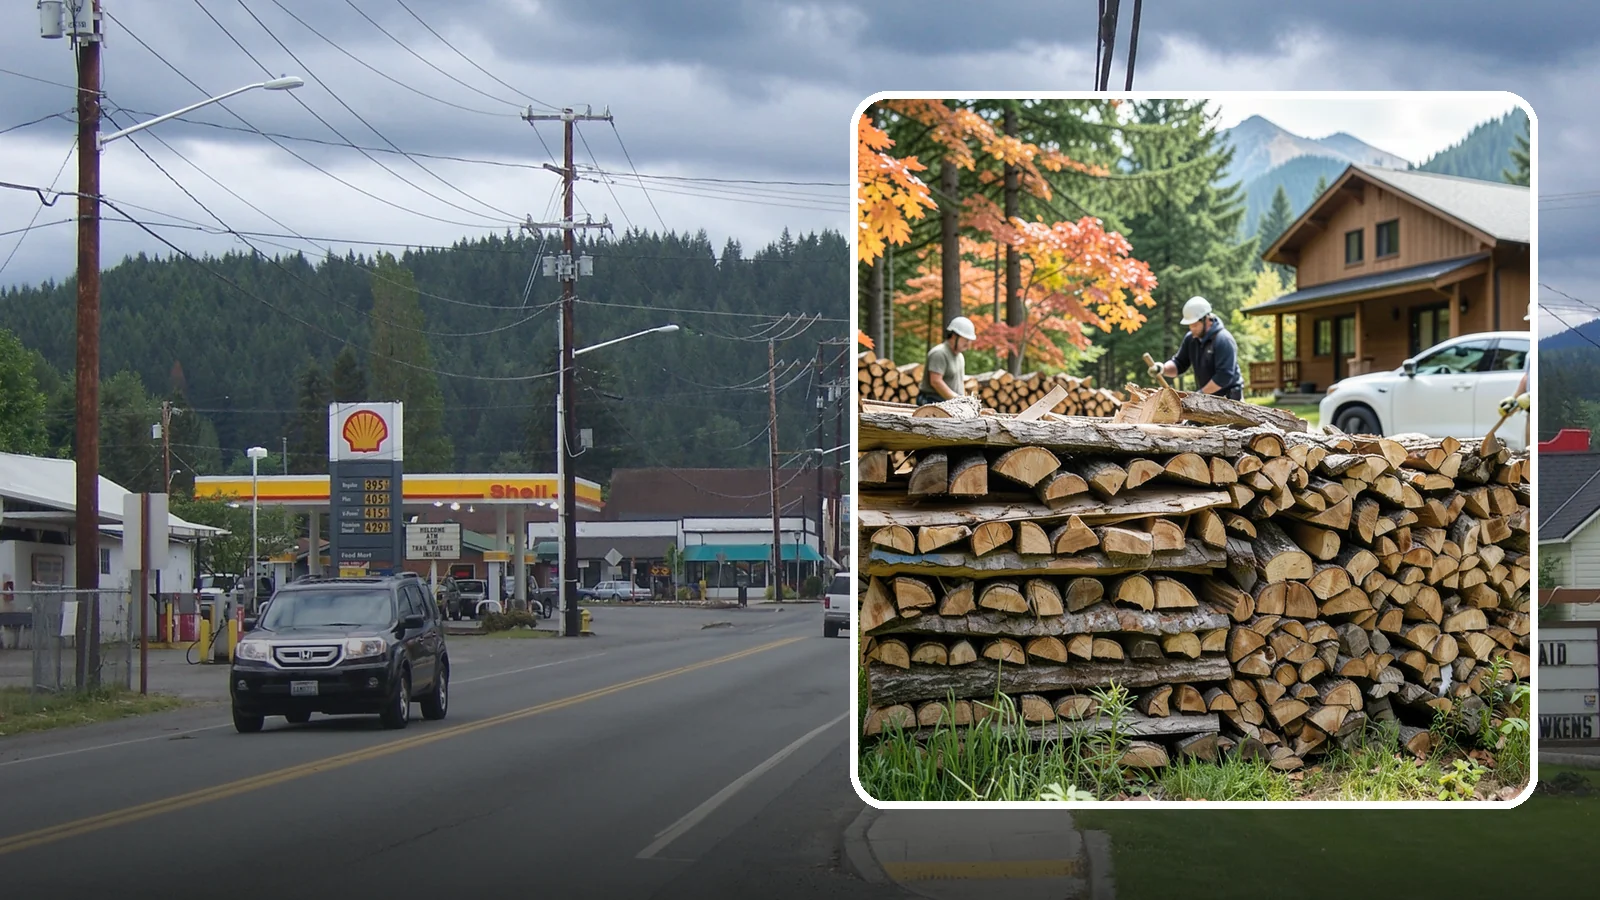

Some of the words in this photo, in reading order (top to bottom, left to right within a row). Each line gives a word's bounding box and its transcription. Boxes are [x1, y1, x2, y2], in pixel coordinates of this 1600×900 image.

[366, 480, 384, 490] 395
[490, 484, 547, 499] Shell
[366, 494, 384, 504] 405
[366, 508, 384, 518] 415
[366, 522, 384, 532] 429
[1539, 643, 1566, 665] AID
